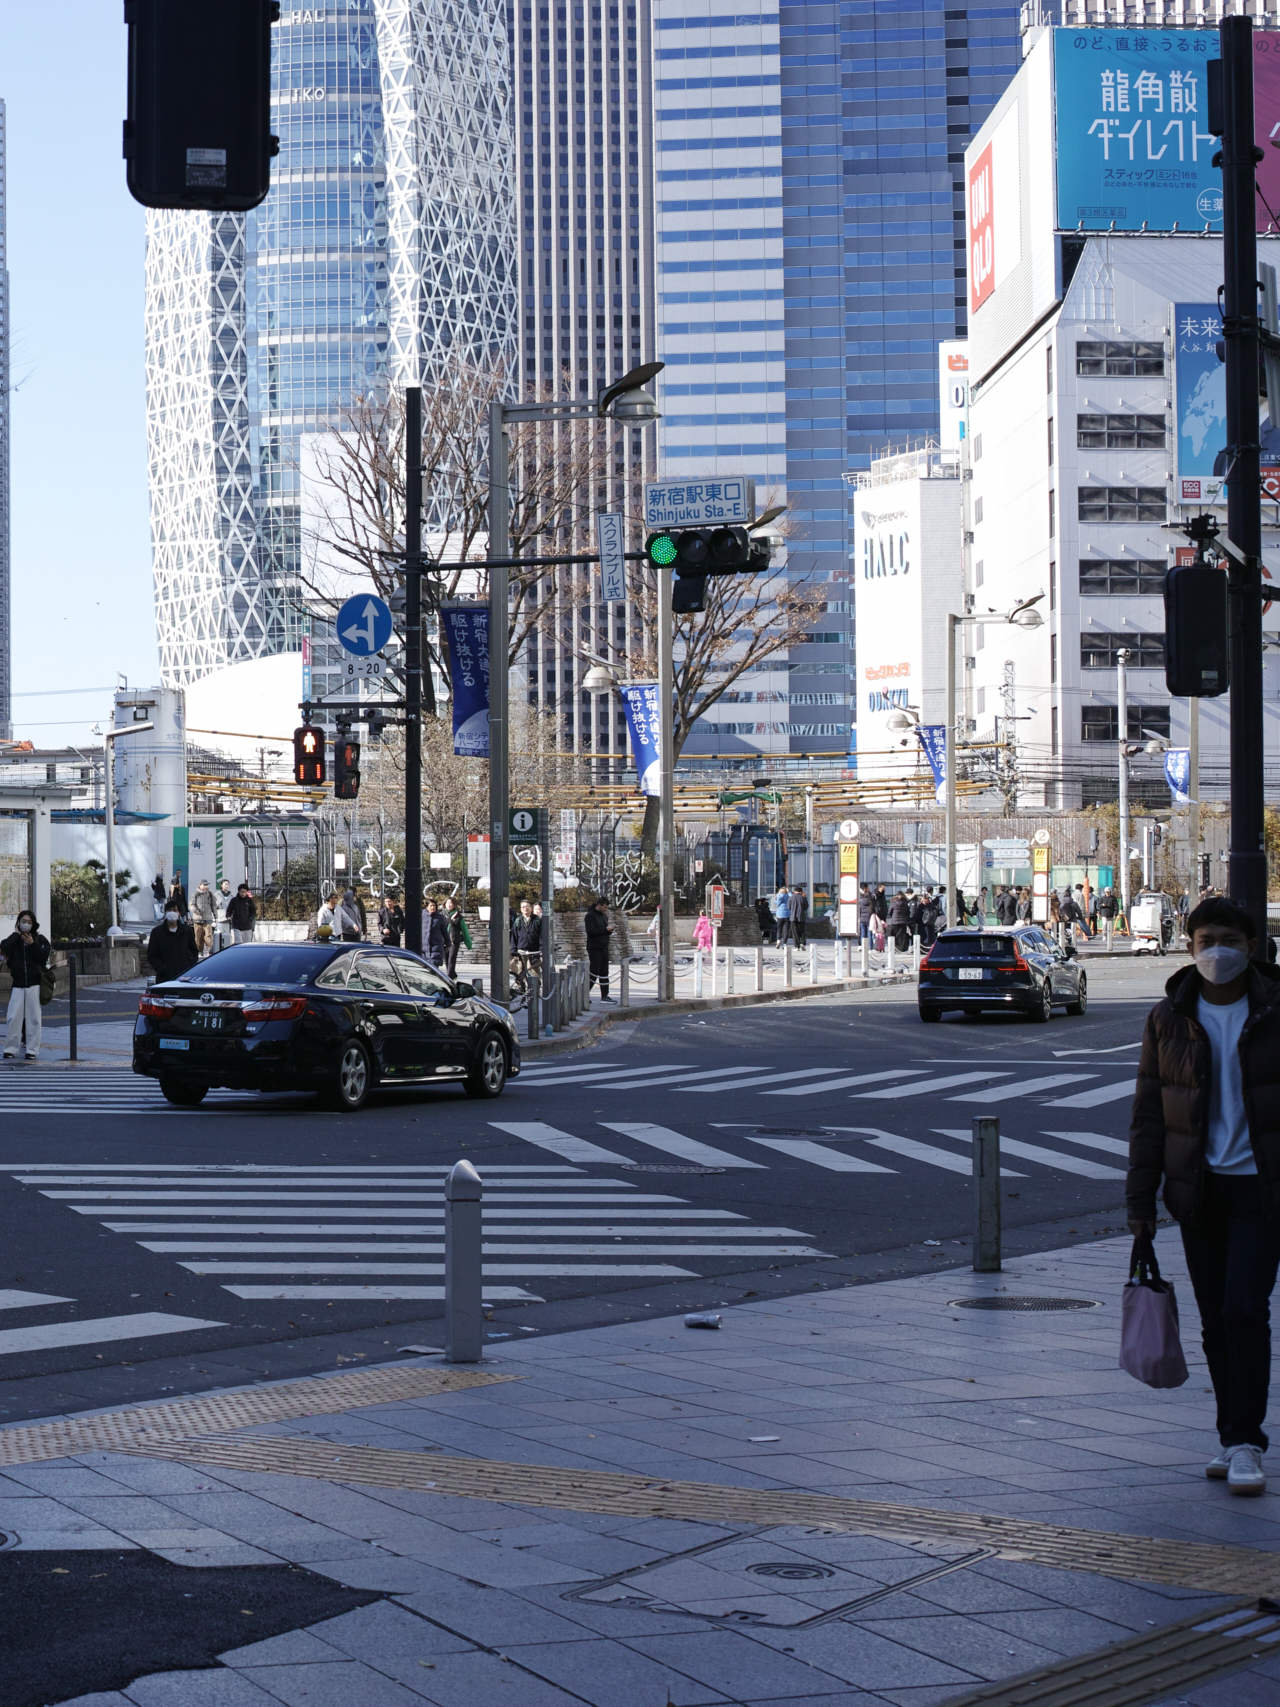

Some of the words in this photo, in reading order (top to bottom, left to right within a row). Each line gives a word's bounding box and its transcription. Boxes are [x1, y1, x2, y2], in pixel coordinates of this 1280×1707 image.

[291, 10, 325, 24] HAL
[1100, 69, 1198, 114] 龍角散
[1087, 118, 1218, 162] ダイレクト
[1104, 168, 1155, 180] スティック
[1158, 170, 1178, 179] ミント
[971, 164, 989, 230] UNI
[1079, 207, 1125, 217] 第3類医薬品
[973, 225, 992, 297] QLO
[1179, 316, 1225, 338] 未来
[648, 482, 741, 507] 新宿駅東口
[648, 507, 701, 523] Shinjuku
[704, 502, 744, 518] Sta.-E.
[603, 517, 621, 598] スクランブル式
[864, 531, 910, 580] HALC
[449, 613, 475, 688] 駆け抜ける
[627, 690, 650, 745] 駆け抜ける
[845, 822, 852, 835] 1
[1038, 831, 1047, 841] 2
